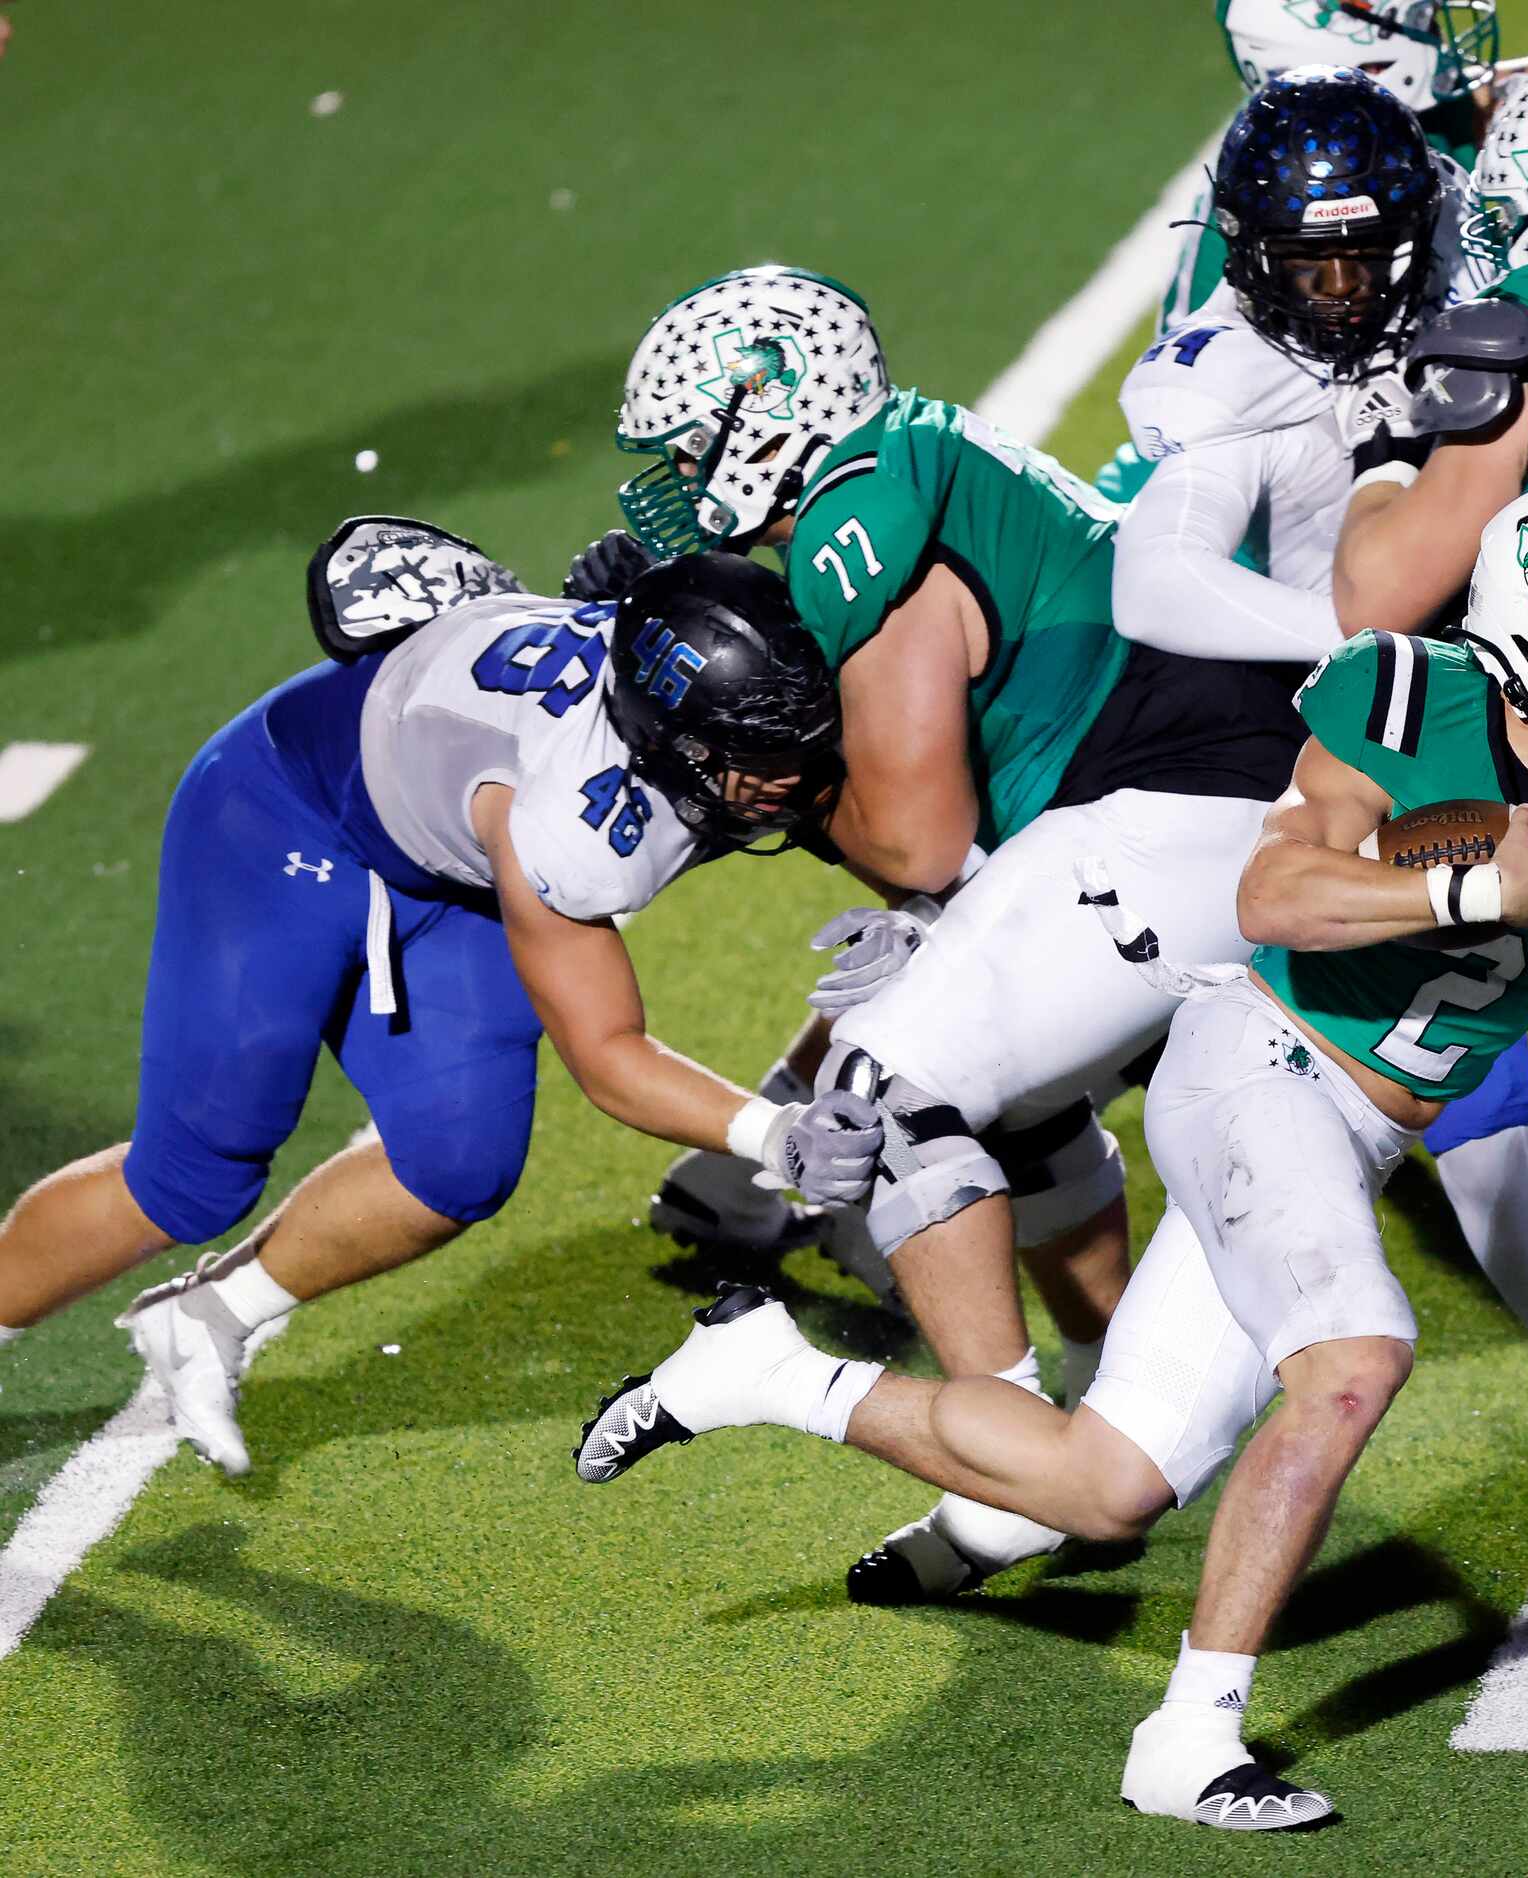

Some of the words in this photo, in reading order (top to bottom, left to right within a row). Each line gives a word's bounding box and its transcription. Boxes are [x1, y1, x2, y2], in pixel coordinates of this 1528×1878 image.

[810, 515, 884, 603] 77
[631, 617, 708, 710] 46
[578, 764, 654, 859] 46
[1370, 932, 1527, 1083] 2
